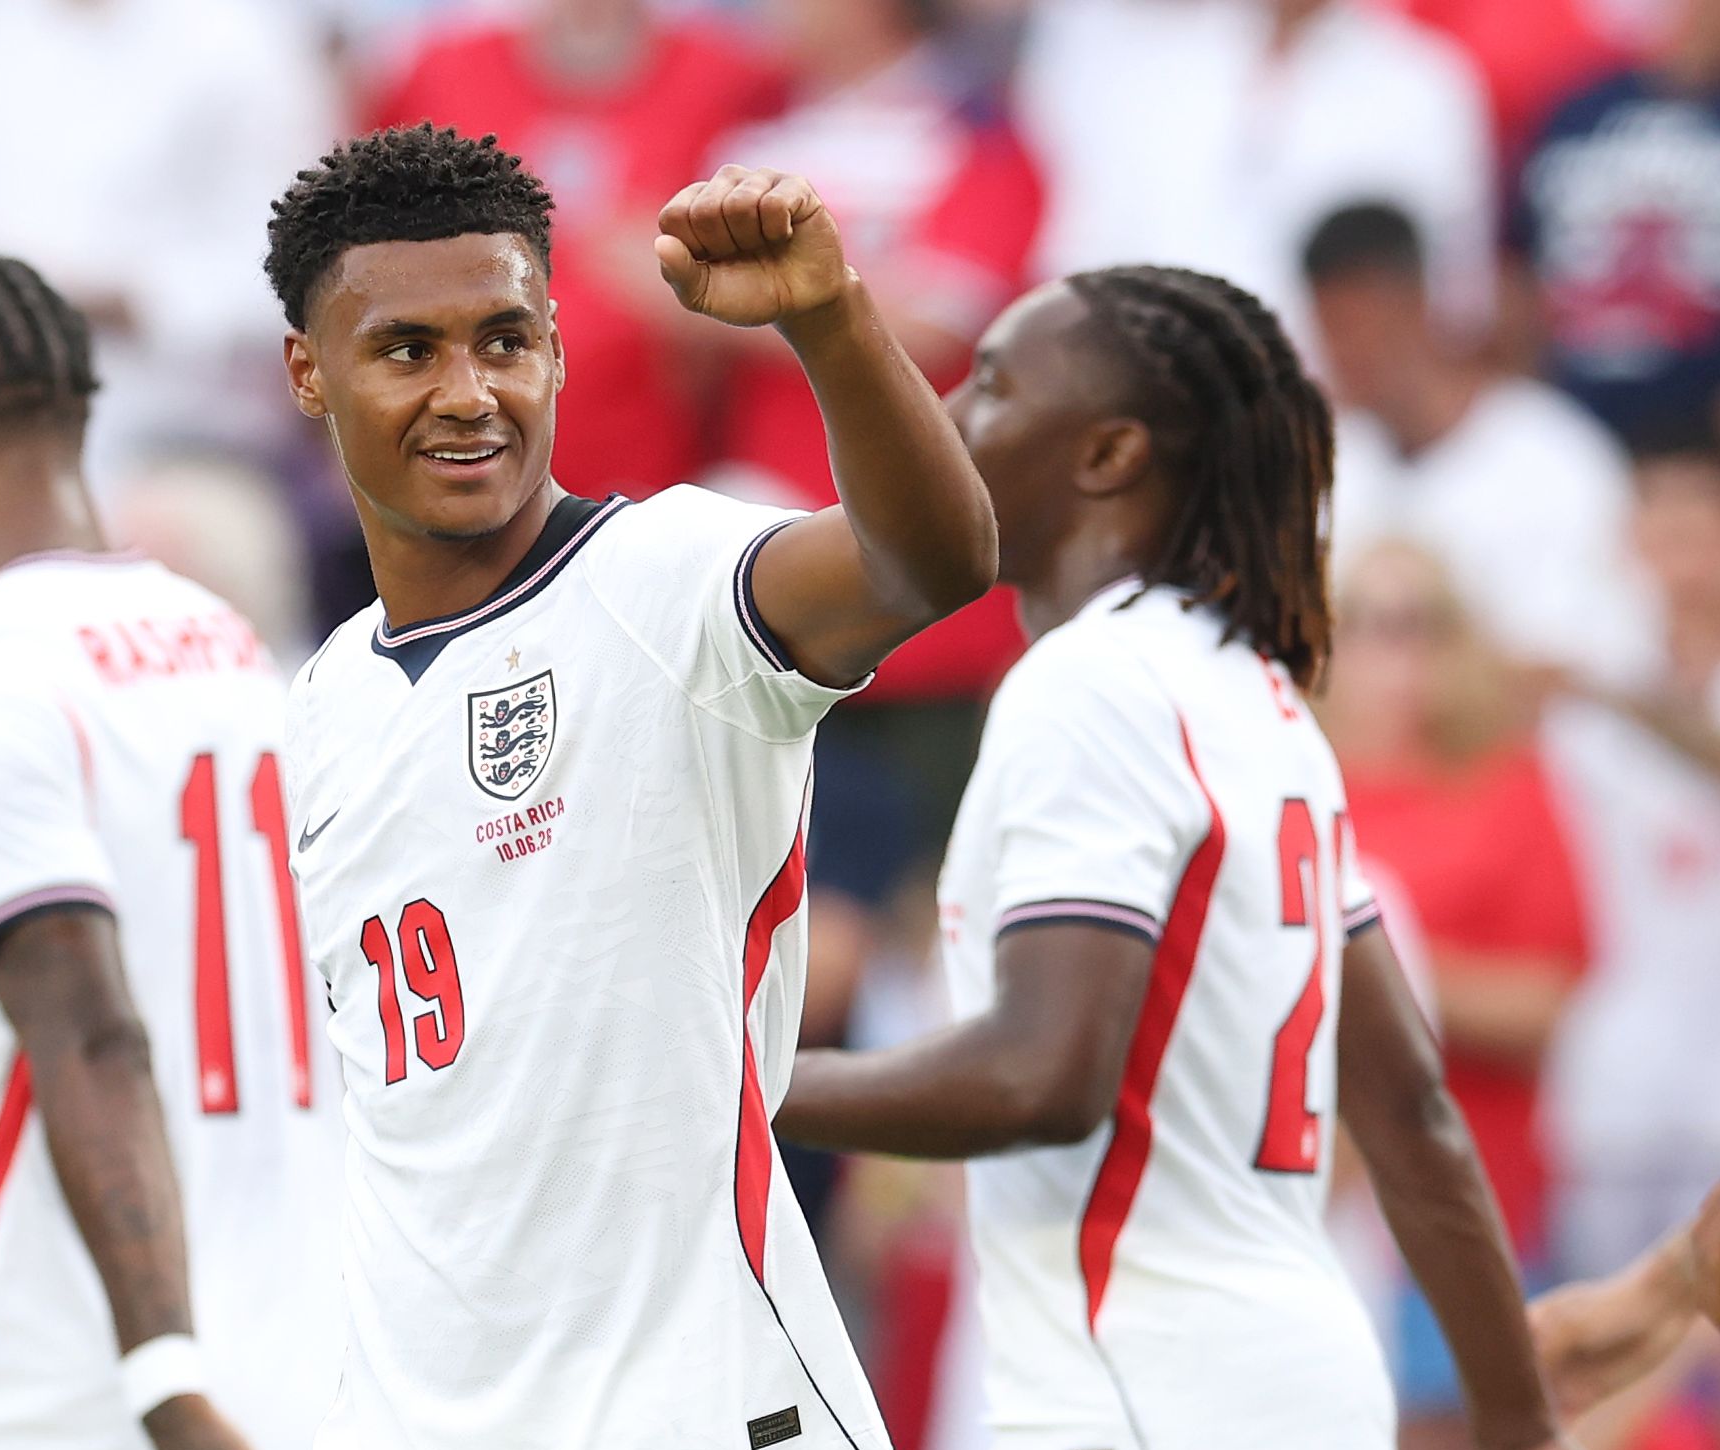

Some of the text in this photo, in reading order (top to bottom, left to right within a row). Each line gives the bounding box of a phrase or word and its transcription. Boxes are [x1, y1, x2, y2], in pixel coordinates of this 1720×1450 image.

[476, 796, 565, 843] COSTA RICA
[495, 827, 552, 863] 10.06.26
[179, 752, 312, 1113] 11
[360, 897, 465, 1087] 19
[1254, 797, 1348, 1174] 2
